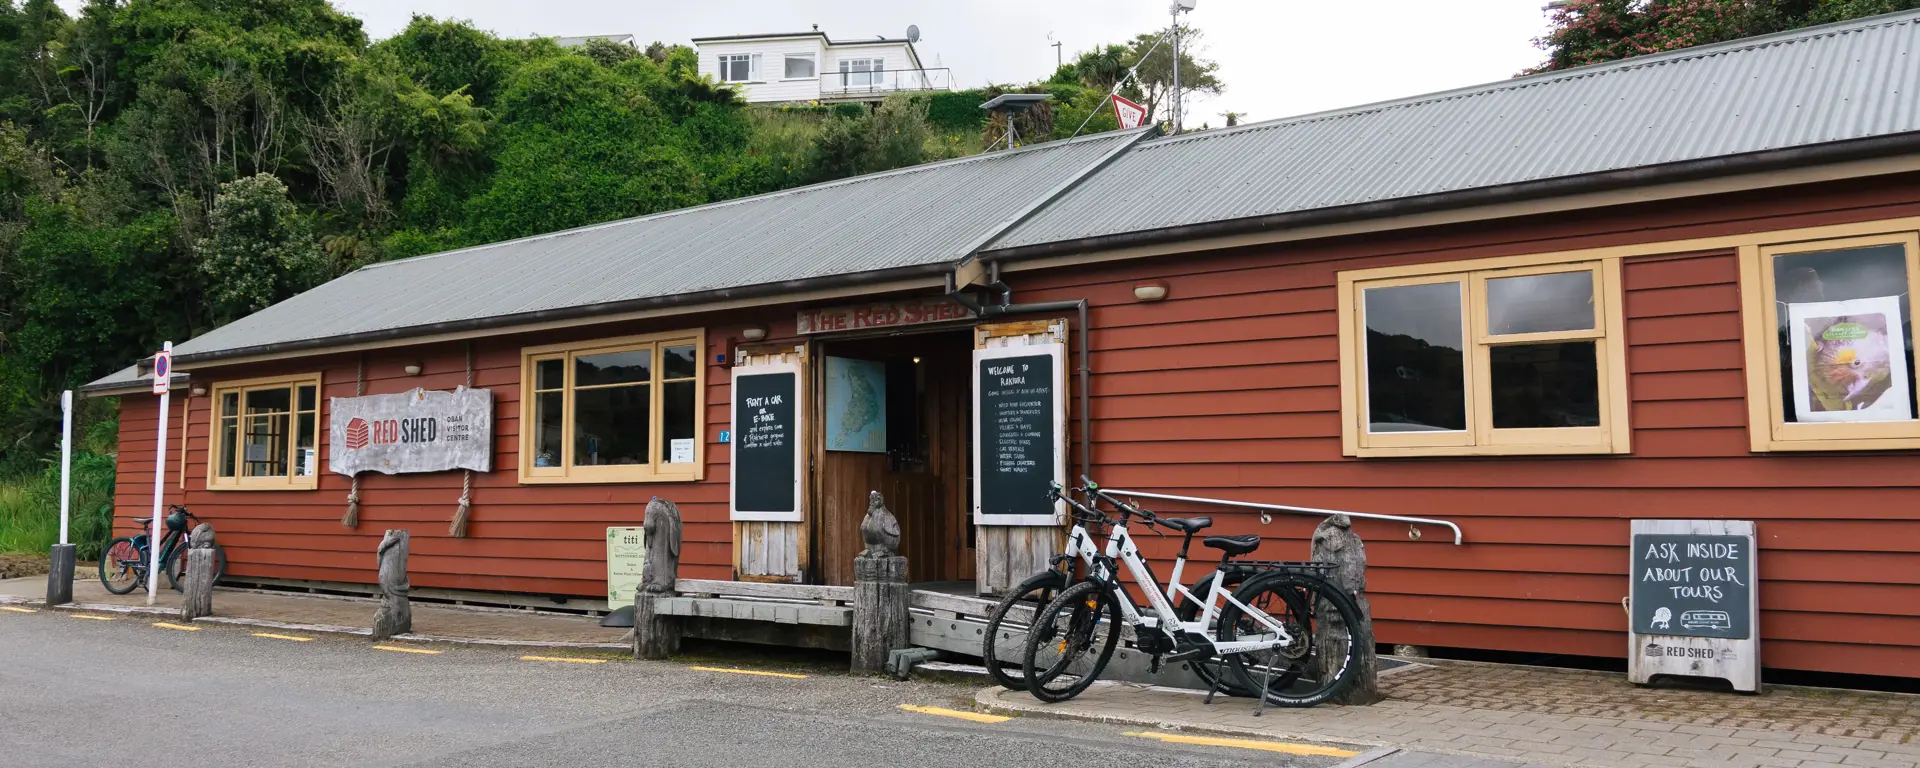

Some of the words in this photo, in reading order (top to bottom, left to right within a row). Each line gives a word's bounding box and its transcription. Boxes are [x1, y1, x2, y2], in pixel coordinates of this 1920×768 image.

[1122, 107, 1136, 122] GIVE
[807, 311, 846, 332] THE
[853, 306, 900, 328] RED
[904, 302, 968, 322] SHED
[988, 365, 1014, 375] WELCOME
[1022, 363, 1029, 372] TO
[1001, 377, 1025, 386] RAKIURA
[746, 398, 762, 408] RENT
[765, 397, 769, 405] A
[771, 395, 782, 404] CAR
[373, 419, 398, 444] RED
[401, 417, 437, 444] SHED
[749, 423, 757, 433] and
[624, 535, 638, 544] titi
[1645, 543, 1680, 563] ASK
[1687, 543, 1738, 559] INSIDE
[1642, 567, 1692, 582] ABOUT
[1699, 566, 1745, 586] OUR
[1668, 585, 1723, 603] TOURS
[1666, 646, 1685, 657] RED
[1687, 647, 1714, 659] SHED
